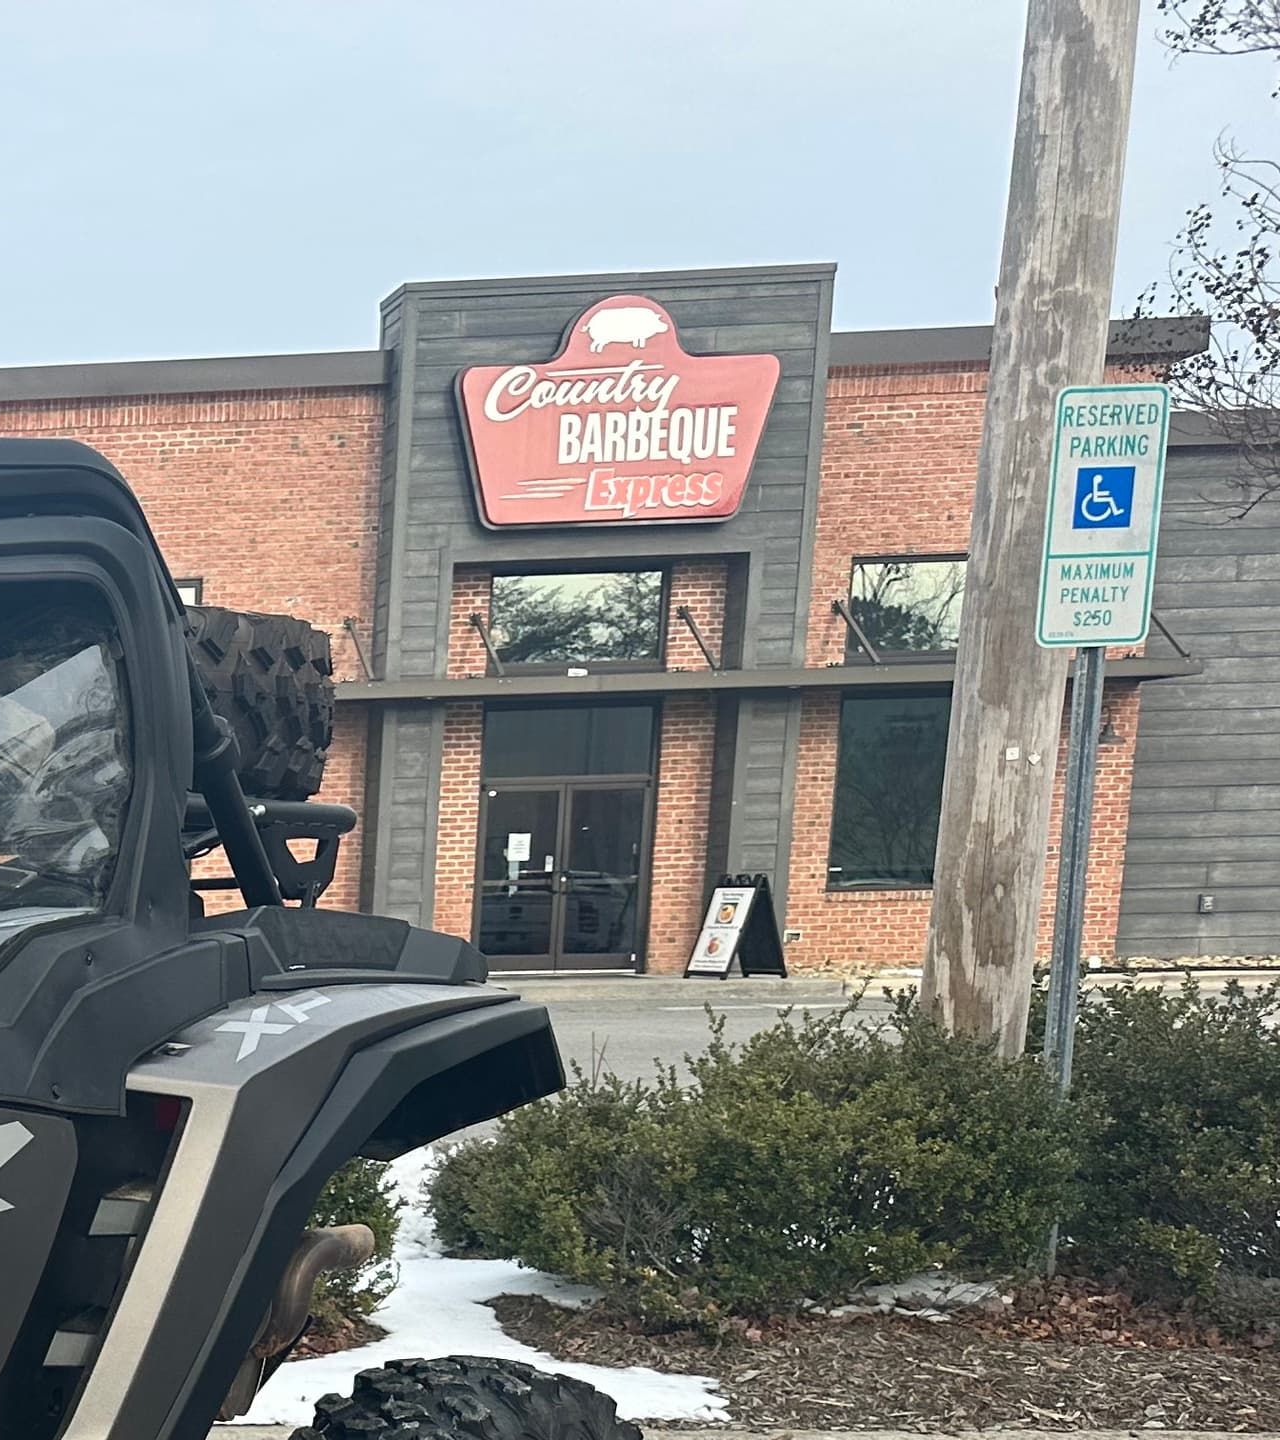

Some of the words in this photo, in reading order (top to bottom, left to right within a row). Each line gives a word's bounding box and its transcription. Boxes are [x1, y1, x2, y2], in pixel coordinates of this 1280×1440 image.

[484, 360, 679, 421] Country
[1063, 403, 1159, 427] RESERVED
[558, 406, 738, 465] BARBEQUE
[1070, 434, 1149, 458] PARKING
[584, 468, 723, 518] Express
[1060, 562, 1134, 580] MAXIMUM
[1060, 586, 1129, 604] PENALTY
[1073, 610, 1112, 626] $250
[214, 990, 332, 1063] XP
